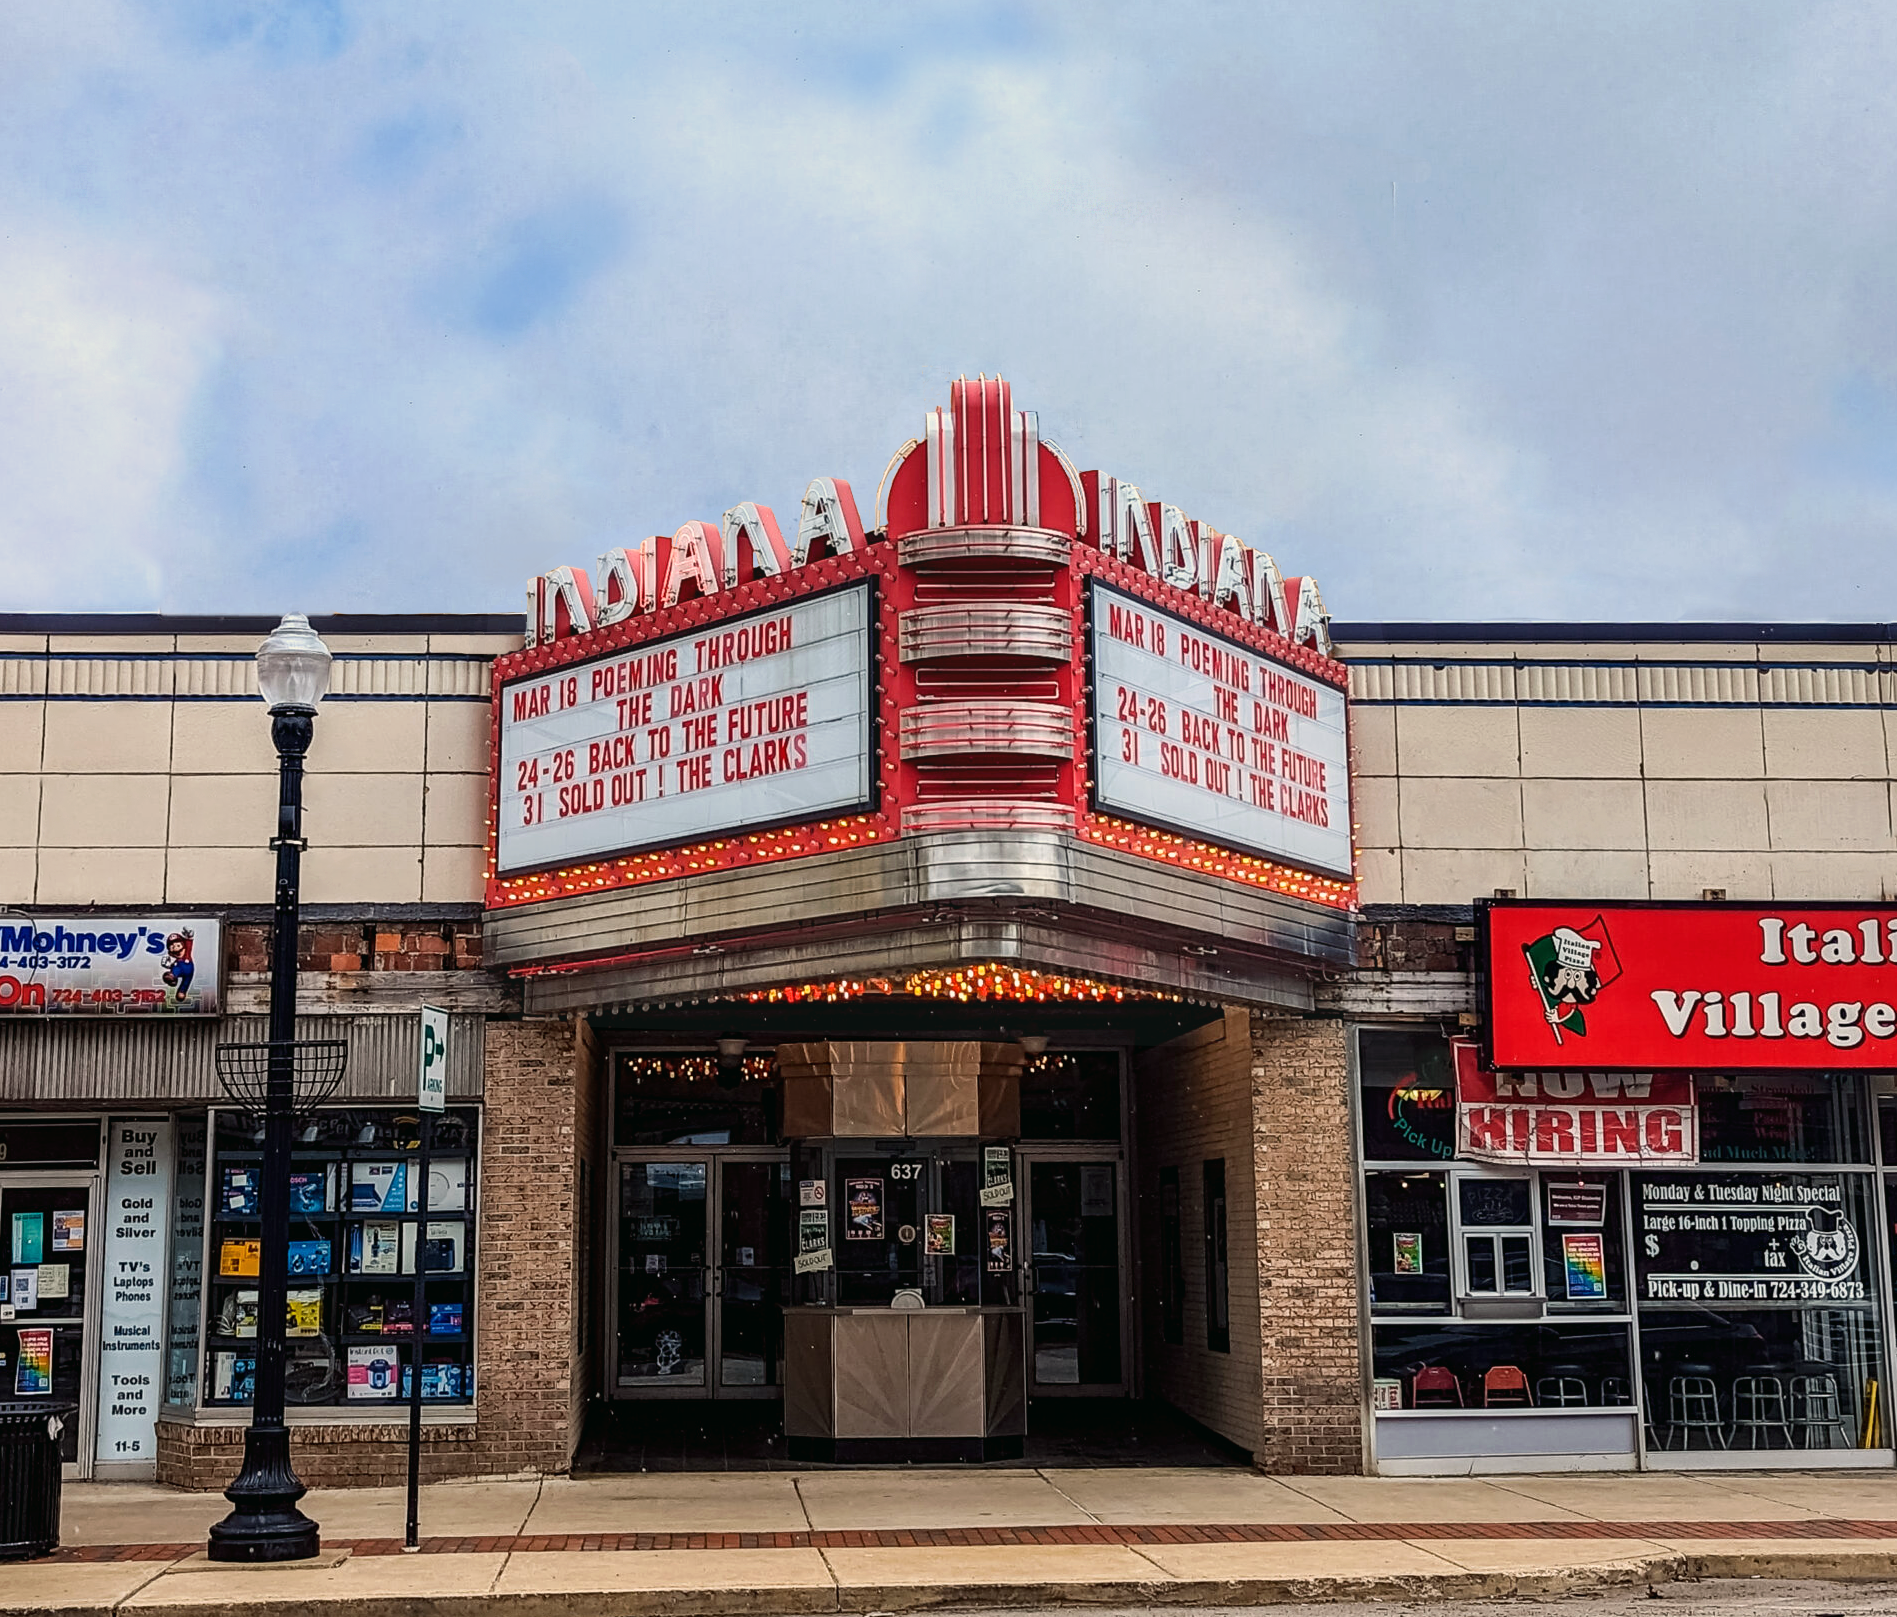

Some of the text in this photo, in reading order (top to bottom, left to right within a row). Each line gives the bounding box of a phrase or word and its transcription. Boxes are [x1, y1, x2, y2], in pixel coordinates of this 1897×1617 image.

[526, 477, 866, 649] INDIANA
[1080, 470, 1333, 656] INDIANA
[513, 616, 792, 723] MAR 18 POEMING THROUGH
[1109, 603, 1318, 721] MAR 18 POEMING THROUGH
[616, 673, 724, 731] THE DARK
[1213, 685, 1289, 744] THE DARK
[518, 692, 808, 791] 24-26 BACK TO THE FUTURE
[1117, 686, 1327, 793] 24-26 BACK TO THE FUTURE
[523, 793, 543, 825] 31
[558, 777, 604, 818] SOLD
[611, 769, 647, 809] OUT
[676, 753, 712, 793] THE
[723, 733, 808, 784] CLARKS
[1121, 727, 1139, 767] 31
[1161, 741, 1198, 786] SOLD
[1205, 758, 1231, 796] OUT
[1250, 772, 1275, 812] THE
[1280, 781, 1330, 829] CLARKS
[1562, 946, 1590, 958] Village
[1563, 938, 1591, 950] Italian
[1564, 955, 1585, 966] Pizza
[0, 974, 46, 1007] On
[1650, 990, 1897, 1048] Village
[121, 1129, 158, 1146] Buy
[1393, 1117, 1453, 1160] Pick Up
[1469, 1107, 1684, 1153] HIRING
[124, 1146, 154, 1158] and
[1725, 1145, 1768, 1159] Much
[120, 1160, 157, 1175] Sell
[890, 1163, 923, 1180] 637
[983, 1185, 1012, 1202] SOLD OUT
[1642, 1183, 1841, 1204] Monday & Tuesday Night Special
[121, 1198, 154, 1209] Gold
[123, 1212, 150, 1224] and
[1643, 1215, 1807, 1233] Large 16-inch 1 Topping Pizza
[115, 1227, 157, 1239] Silver
[1644, 1233, 1661, 1258] $
[118, 1261, 151, 1273] TV's
[1764, 1250, 1787, 1268] tax
[1802, 1255, 1830, 1277] Italian
[1829, 1251, 1855, 1276] Village
[113, 1276, 154, 1289] Laptops
[1647, 1280, 1865, 1300] Pick-up & Dine-in 724-349-6873
[115, 1290, 152, 1302] Phones
[113, 1325, 151, 1336] Musical
[102, 1340, 161, 1351] Instruments
[111, 1374, 151, 1386] Tools
[117, 1388, 143, 1401] and
[111, 1404, 147, 1416] More
[114, 1440, 141, 1452] 11-5
